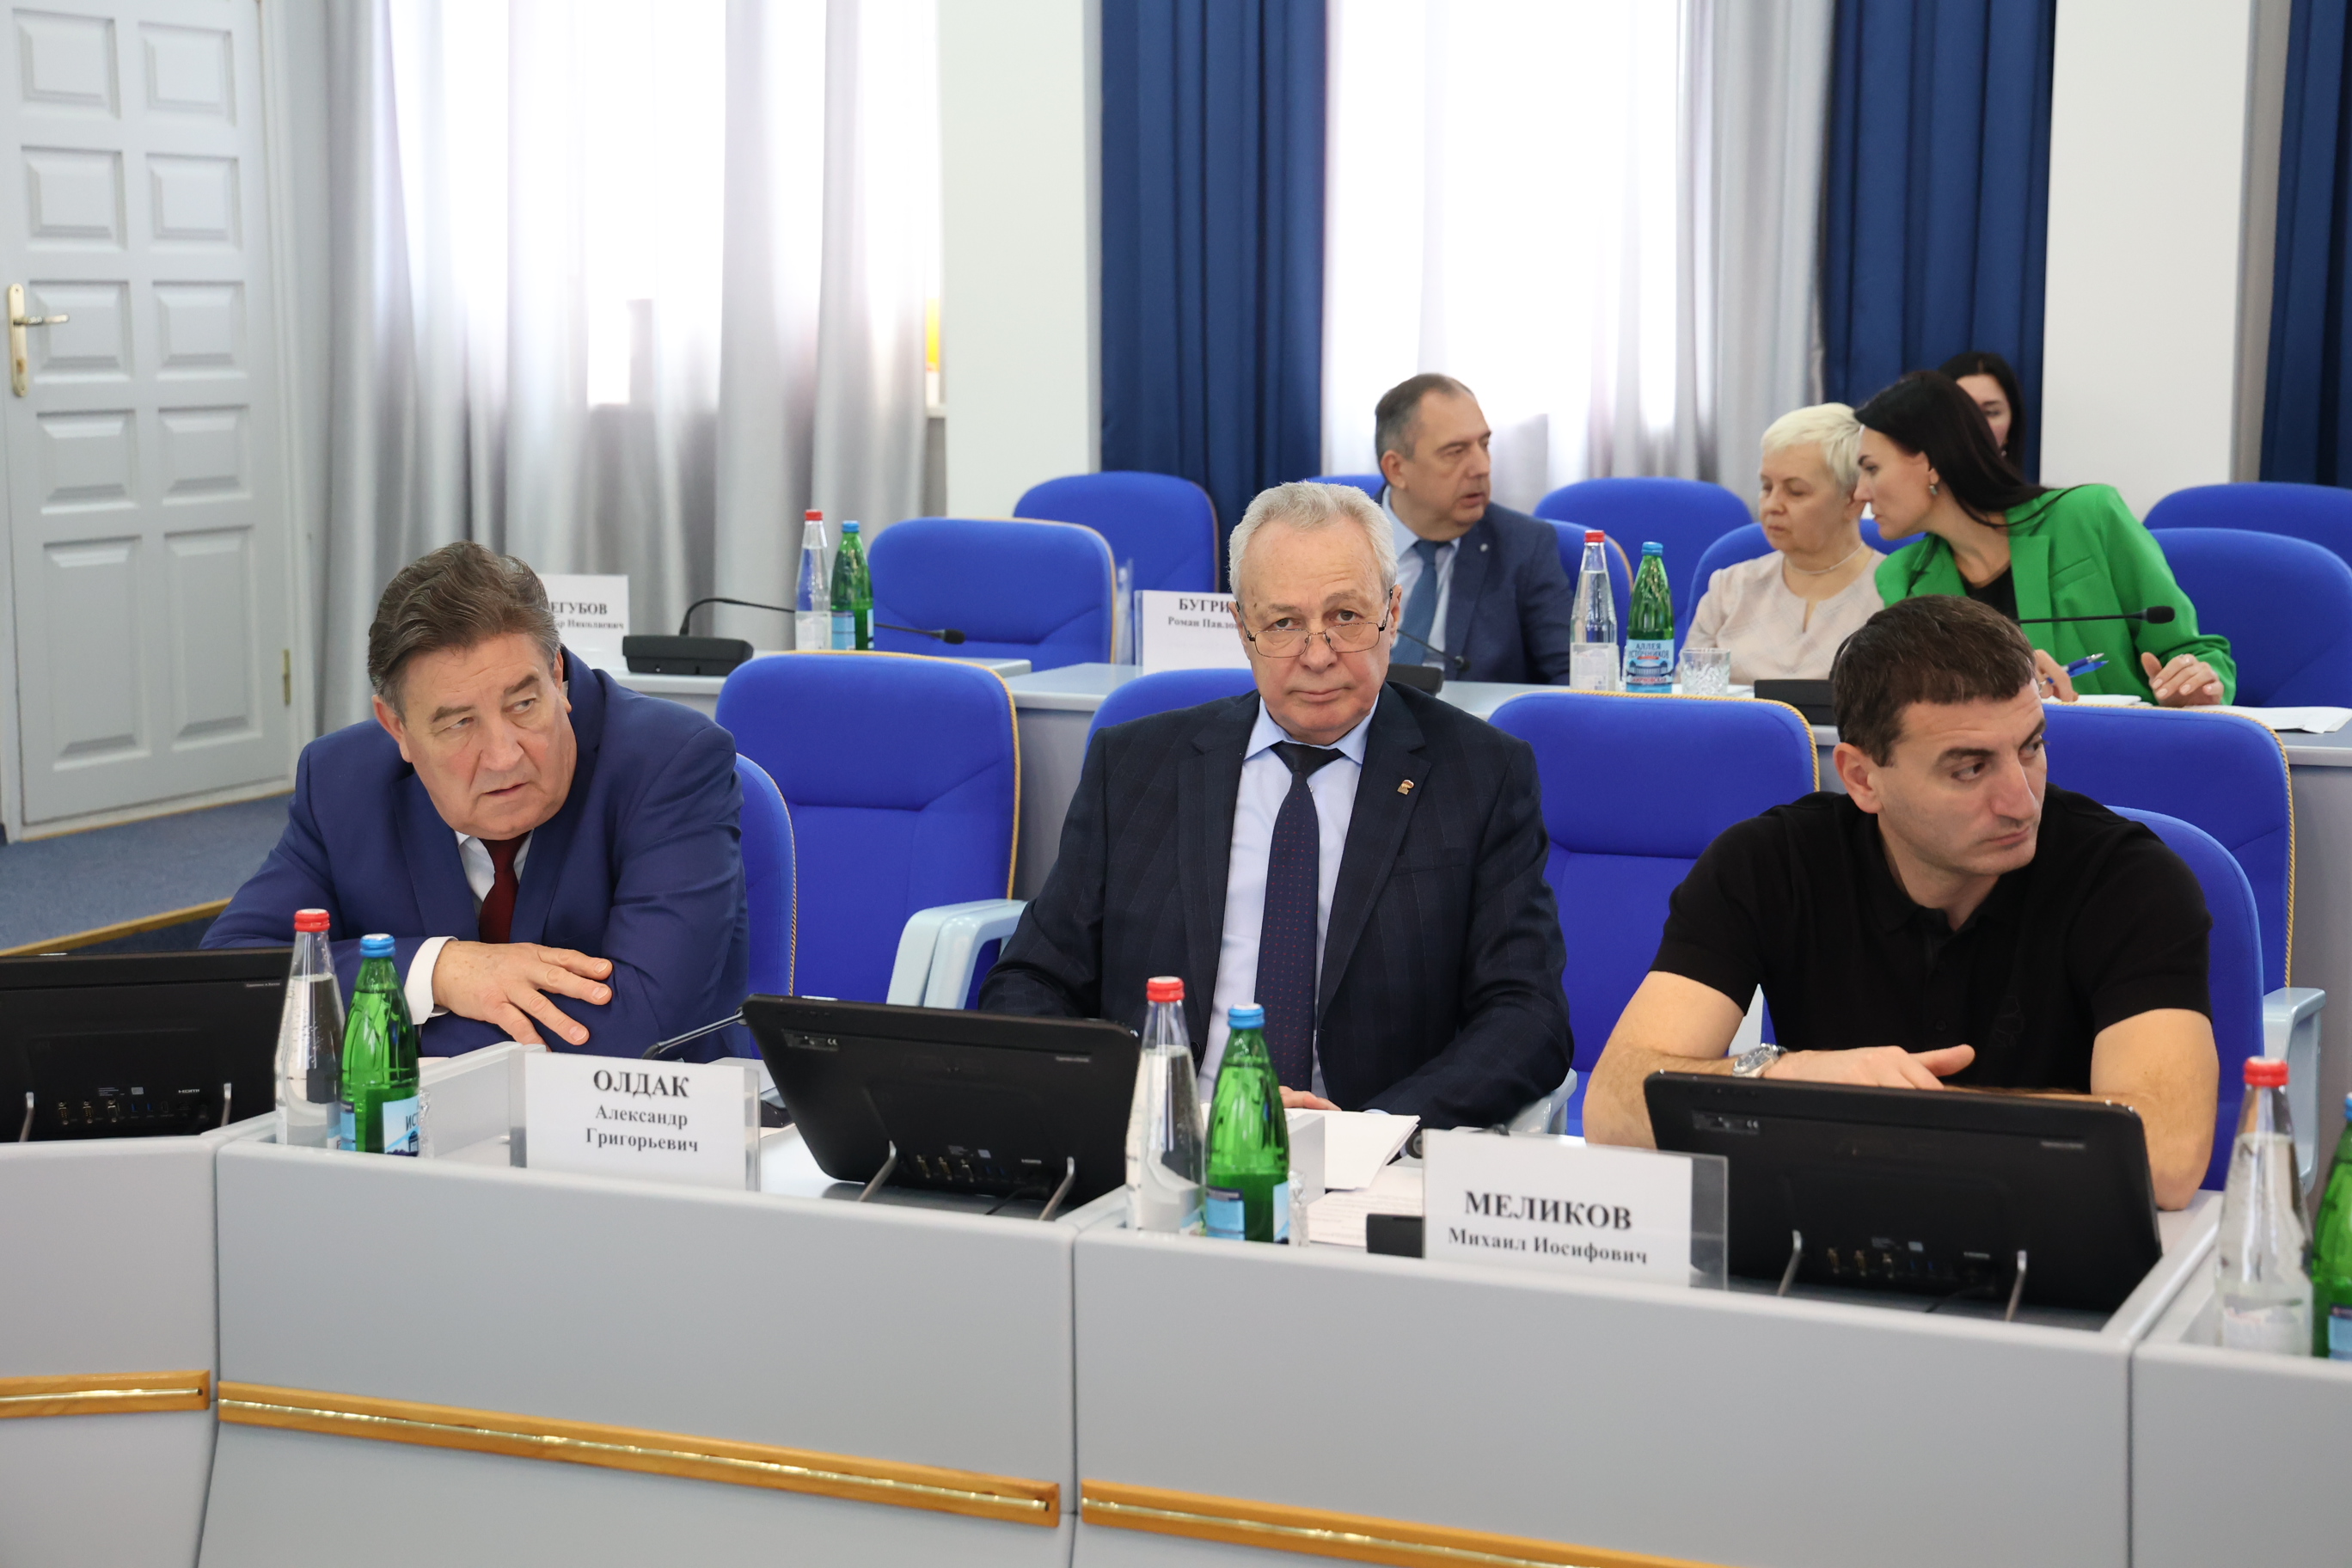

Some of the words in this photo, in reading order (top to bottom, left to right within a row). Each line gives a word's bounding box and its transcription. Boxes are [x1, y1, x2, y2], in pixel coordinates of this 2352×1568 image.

[551, 602, 607, 615] ЕГУБОВ
[1179, 598, 1230, 613] БУГРИ
[1167, 616, 1199, 628] Роман
[1203, 618, 1238, 629] Павло
[593, 1069, 689, 1098] ОЛДАК
[595, 1104, 689, 1130] Александр
[585, 1128, 699, 1153] Григорьевич
[1465, 1191, 1632, 1230] МЕЛИКОВ
[1449, 1228, 1527, 1252] Михаил
[1533, 1236, 1648, 1265] Иосифович
